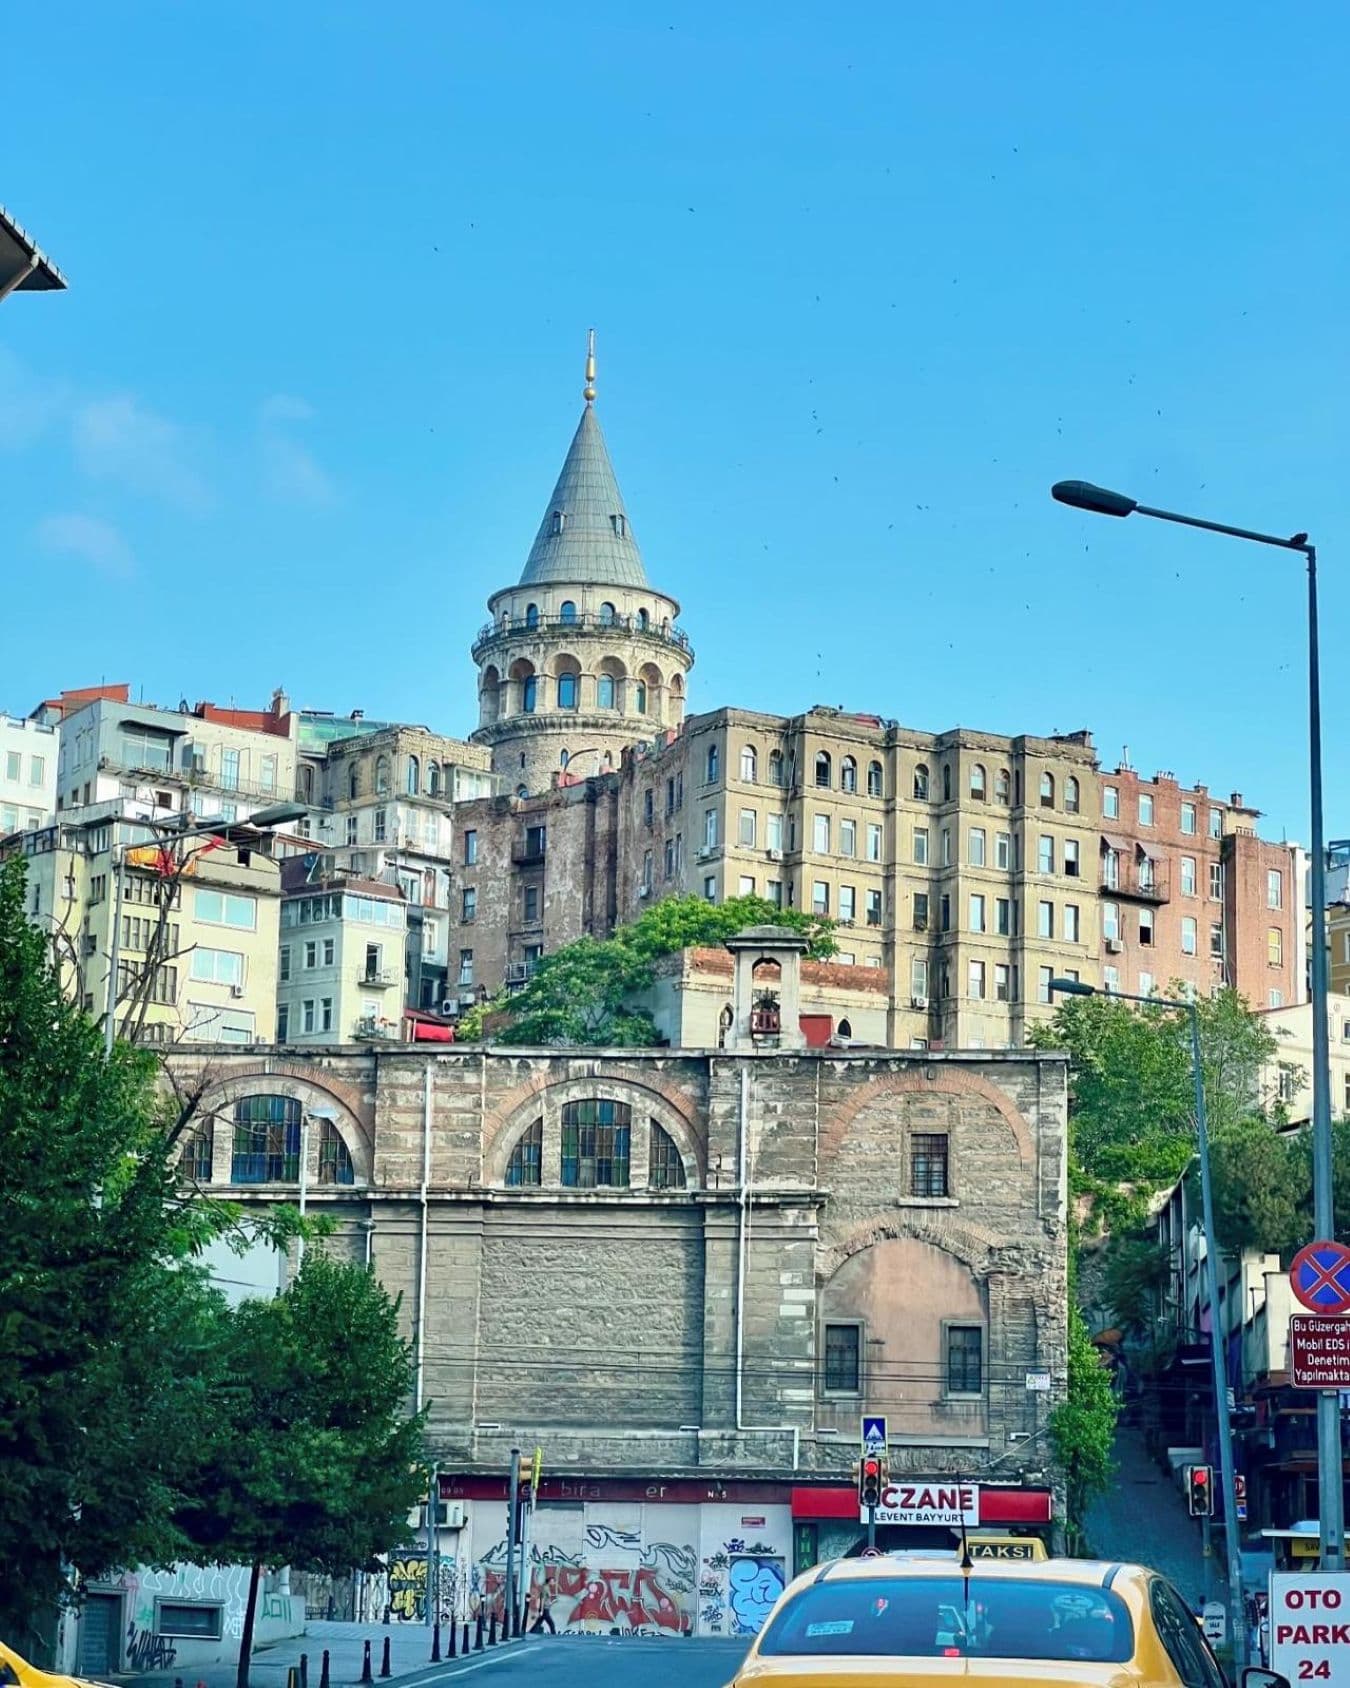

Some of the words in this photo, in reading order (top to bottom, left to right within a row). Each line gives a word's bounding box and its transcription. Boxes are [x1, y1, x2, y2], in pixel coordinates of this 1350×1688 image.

[1294, 1319, 1306, 1332] Bu
[1296, 1338, 1323, 1350] Mobil
[1325, 1338, 1345, 1350] EDS
[1307, 1353, 1350, 1366] Denetim
[881, 1487, 974, 1510] CZANE
[875, 1512, 914, 1521] LEVENT
[915, 1512, 964, 1522] BAYYURT
[1285, 1589, 1342, 1609] OTO
[1277, 1624, 1350, 1645] PARK
[1298, 1659, 1331, 1680] 24
